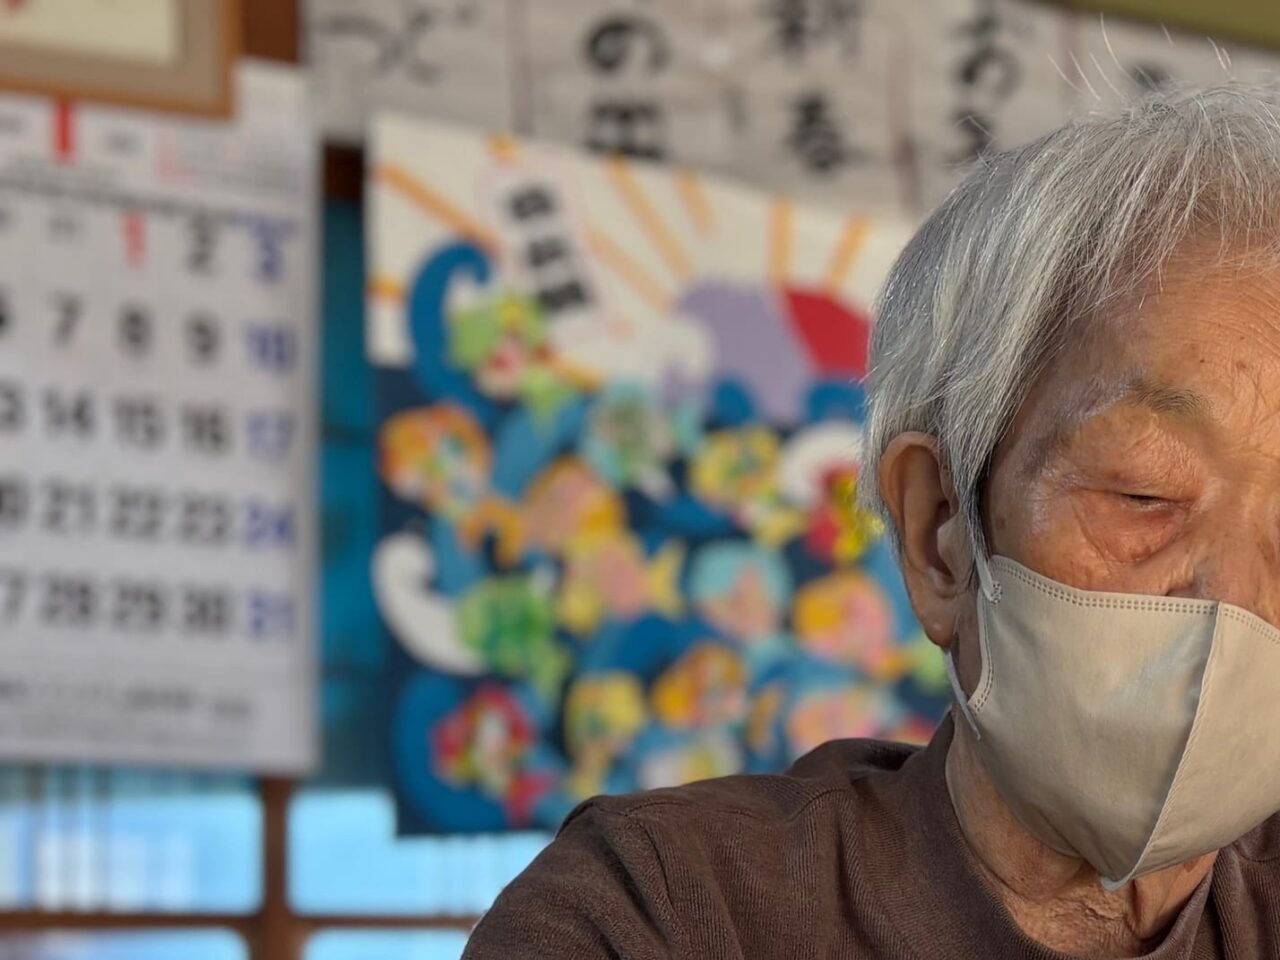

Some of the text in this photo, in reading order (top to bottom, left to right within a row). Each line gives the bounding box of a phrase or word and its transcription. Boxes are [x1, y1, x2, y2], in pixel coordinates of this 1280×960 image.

[52, 292, 84, 350] 7
[116, 305, 154, 357] 8
[184, 314, 222, 366] 9
[45, 388, 95, 440] 14
[113, 394, 164, 449] 15
[182, 404, 232, 456] 16
[43, 480, 95, 533] 21
[110, 487, 165, 540] 22
[179, 495, 233, 546] 23
[43, 575, 97, 627] 28
[111, 581, 167, 634] 29
